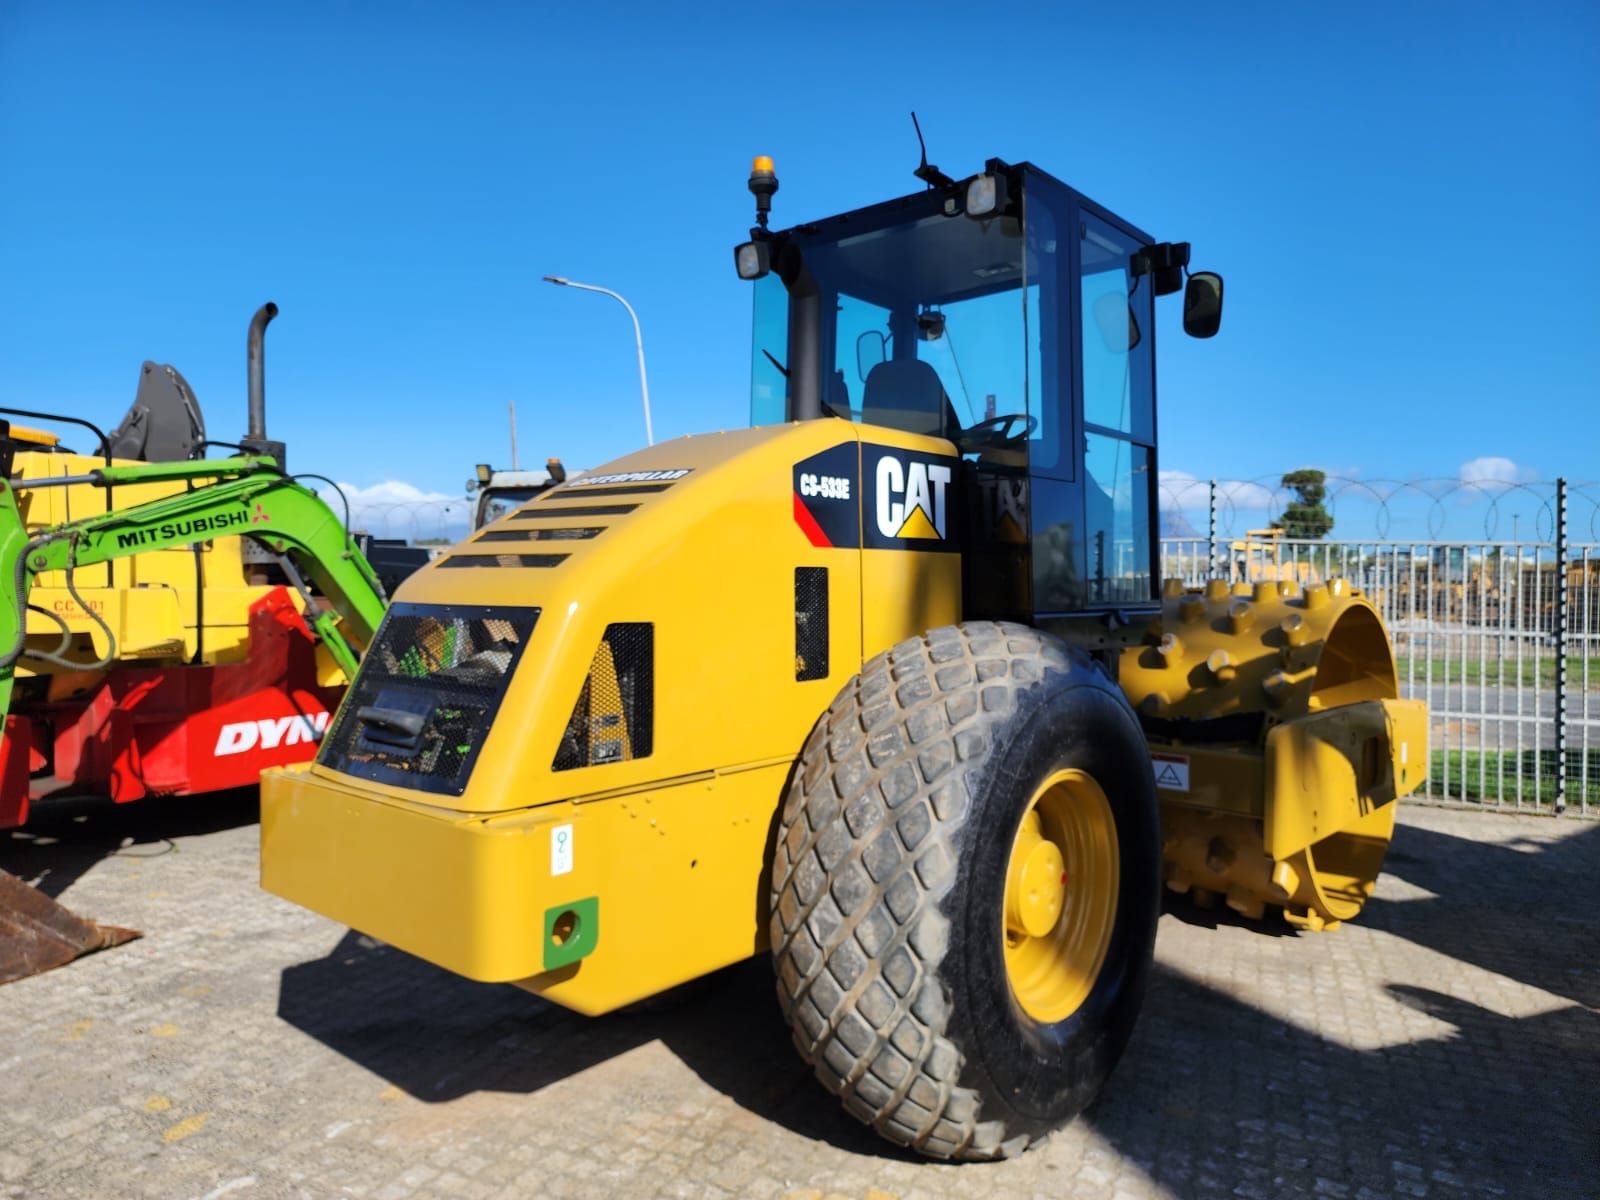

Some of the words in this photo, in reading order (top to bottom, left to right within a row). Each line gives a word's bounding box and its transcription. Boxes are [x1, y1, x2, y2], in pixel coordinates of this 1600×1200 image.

[800, 473, 850, 500] CS-533E
[875, 455, 951, 540] CAT
[116, 510, 249, 548] MITSUBISHI
[213, 711, 333, 757] DYN
